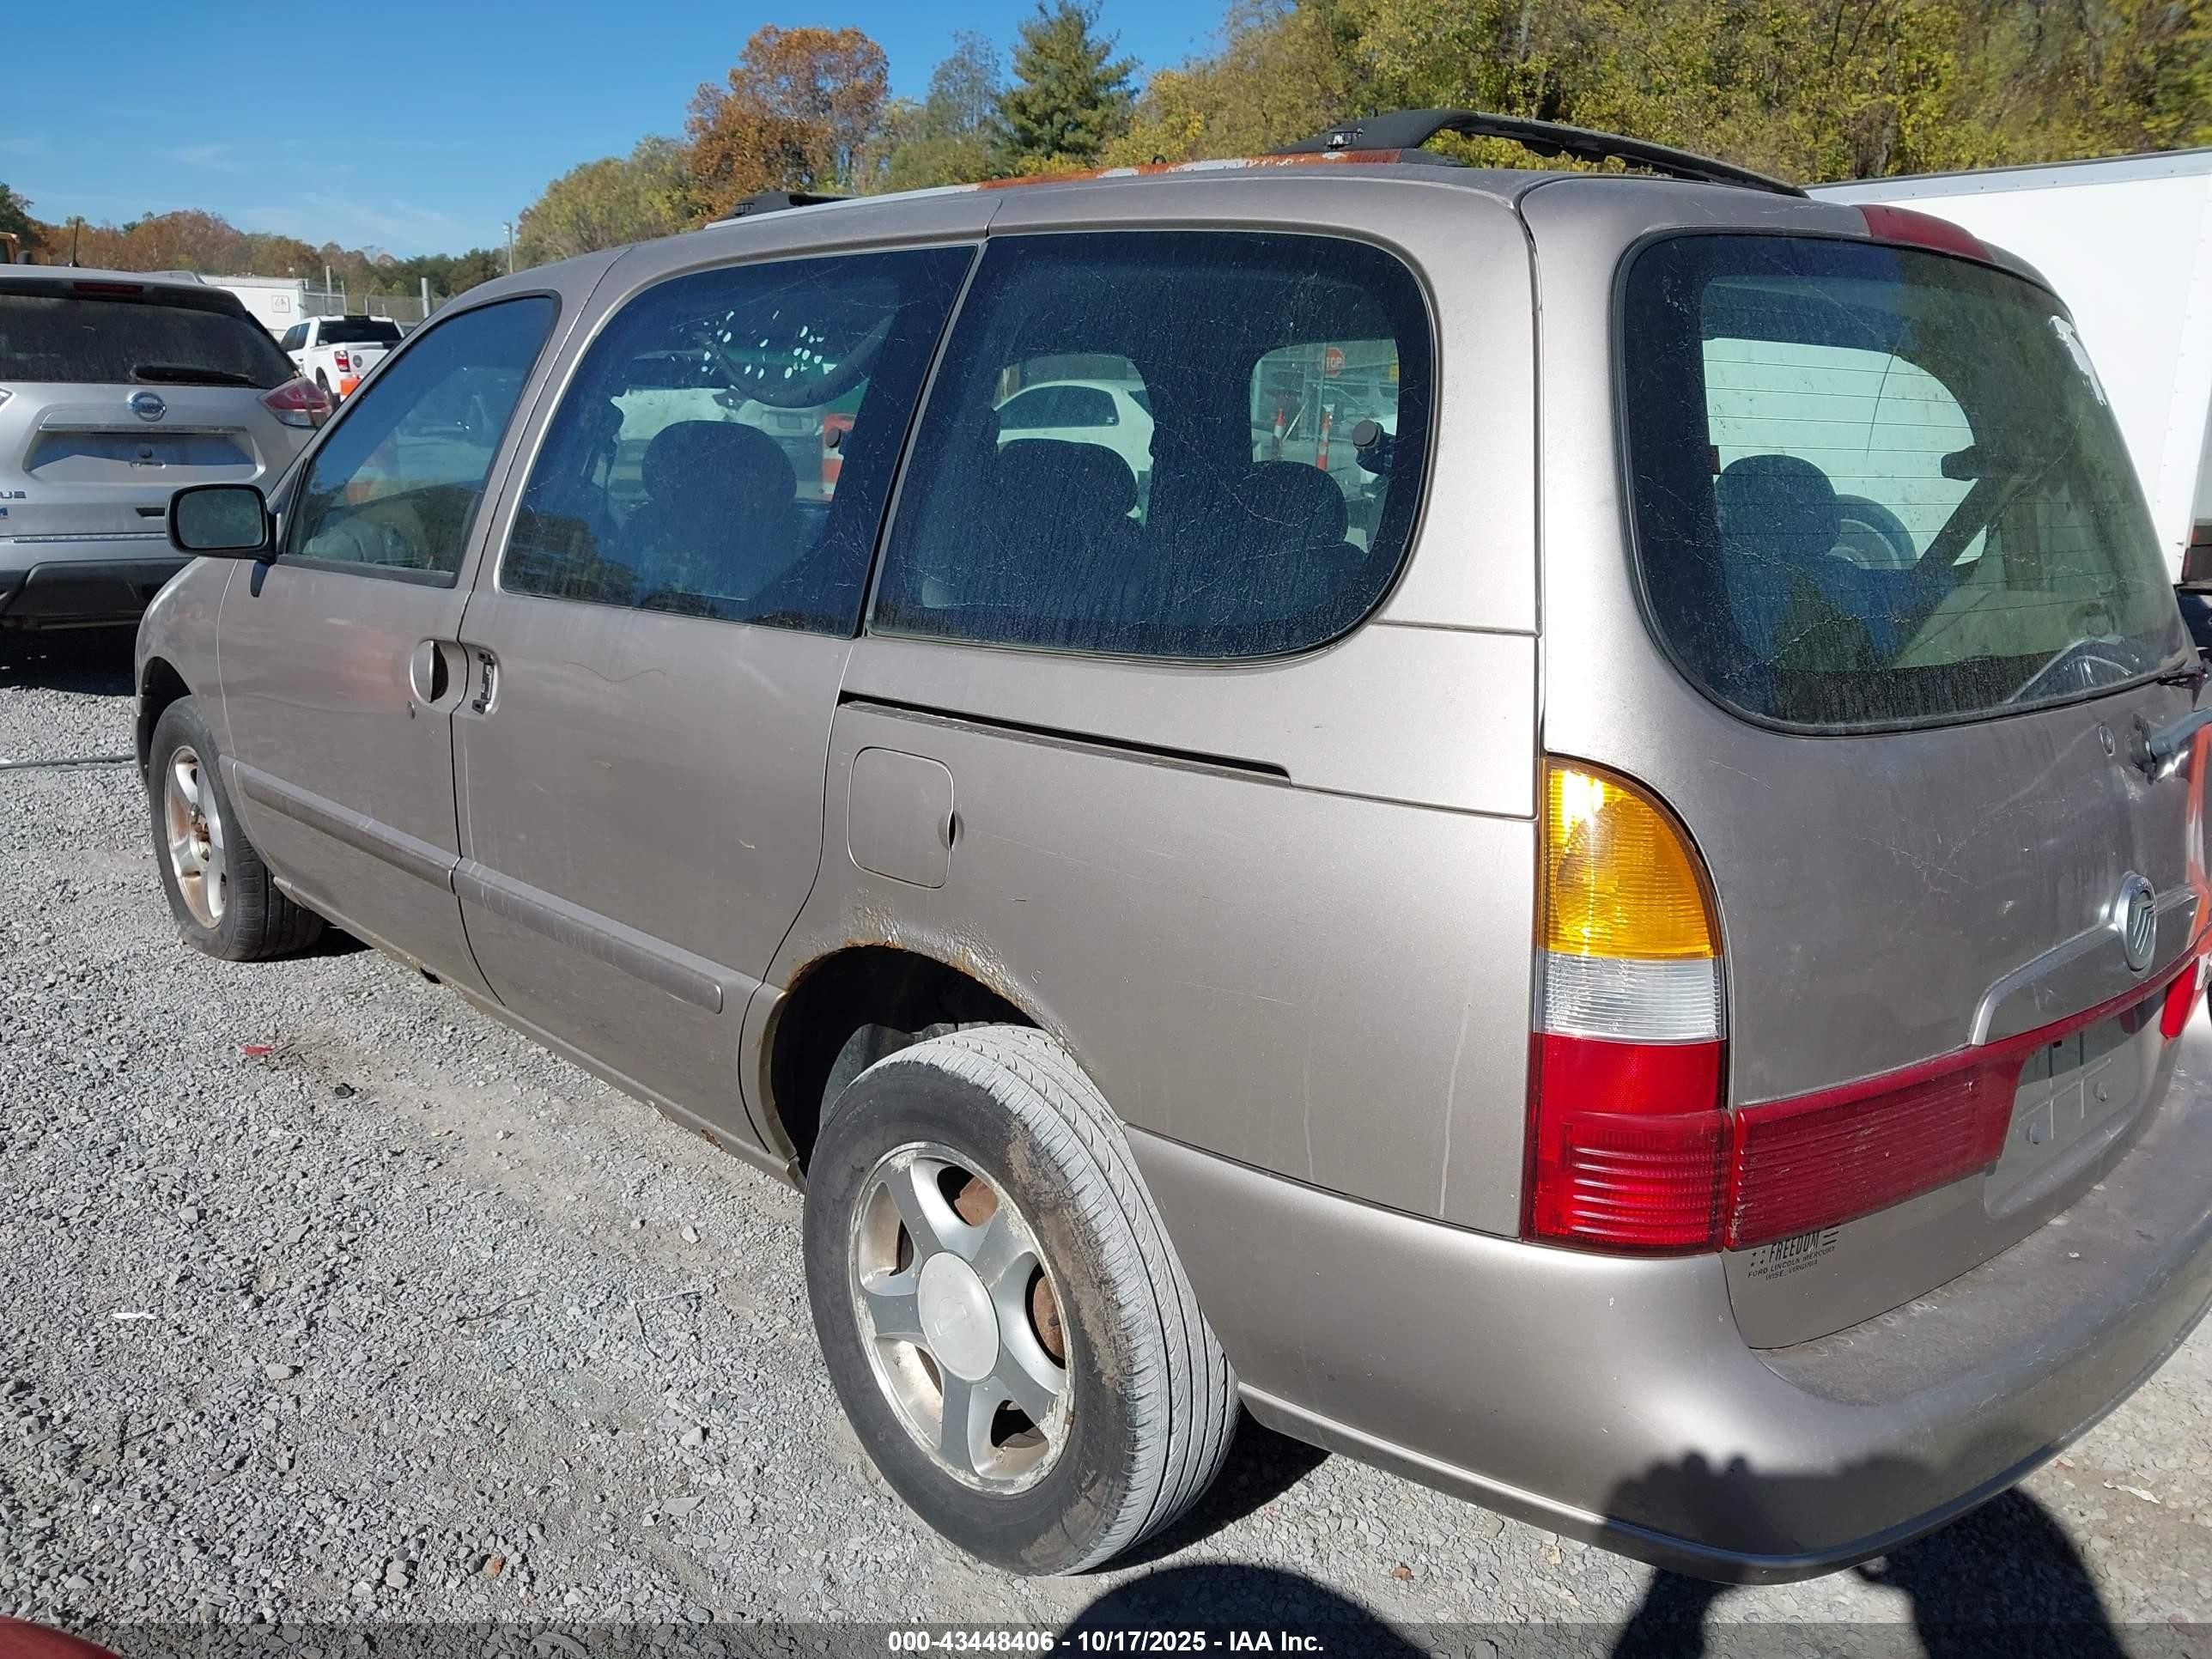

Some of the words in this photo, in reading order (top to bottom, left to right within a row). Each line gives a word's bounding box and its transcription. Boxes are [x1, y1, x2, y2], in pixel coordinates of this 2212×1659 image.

[1769, 1231, 1820, 1262] FREEDOM
[1747, 1267, 1768, 1279] FORD
[1771, 1258, 1801, 1272] LINCOLN
[1803, 1246, 1835, 1261] MERCURY
[1789, 1260, 1818, 1273] VIRGINIA
